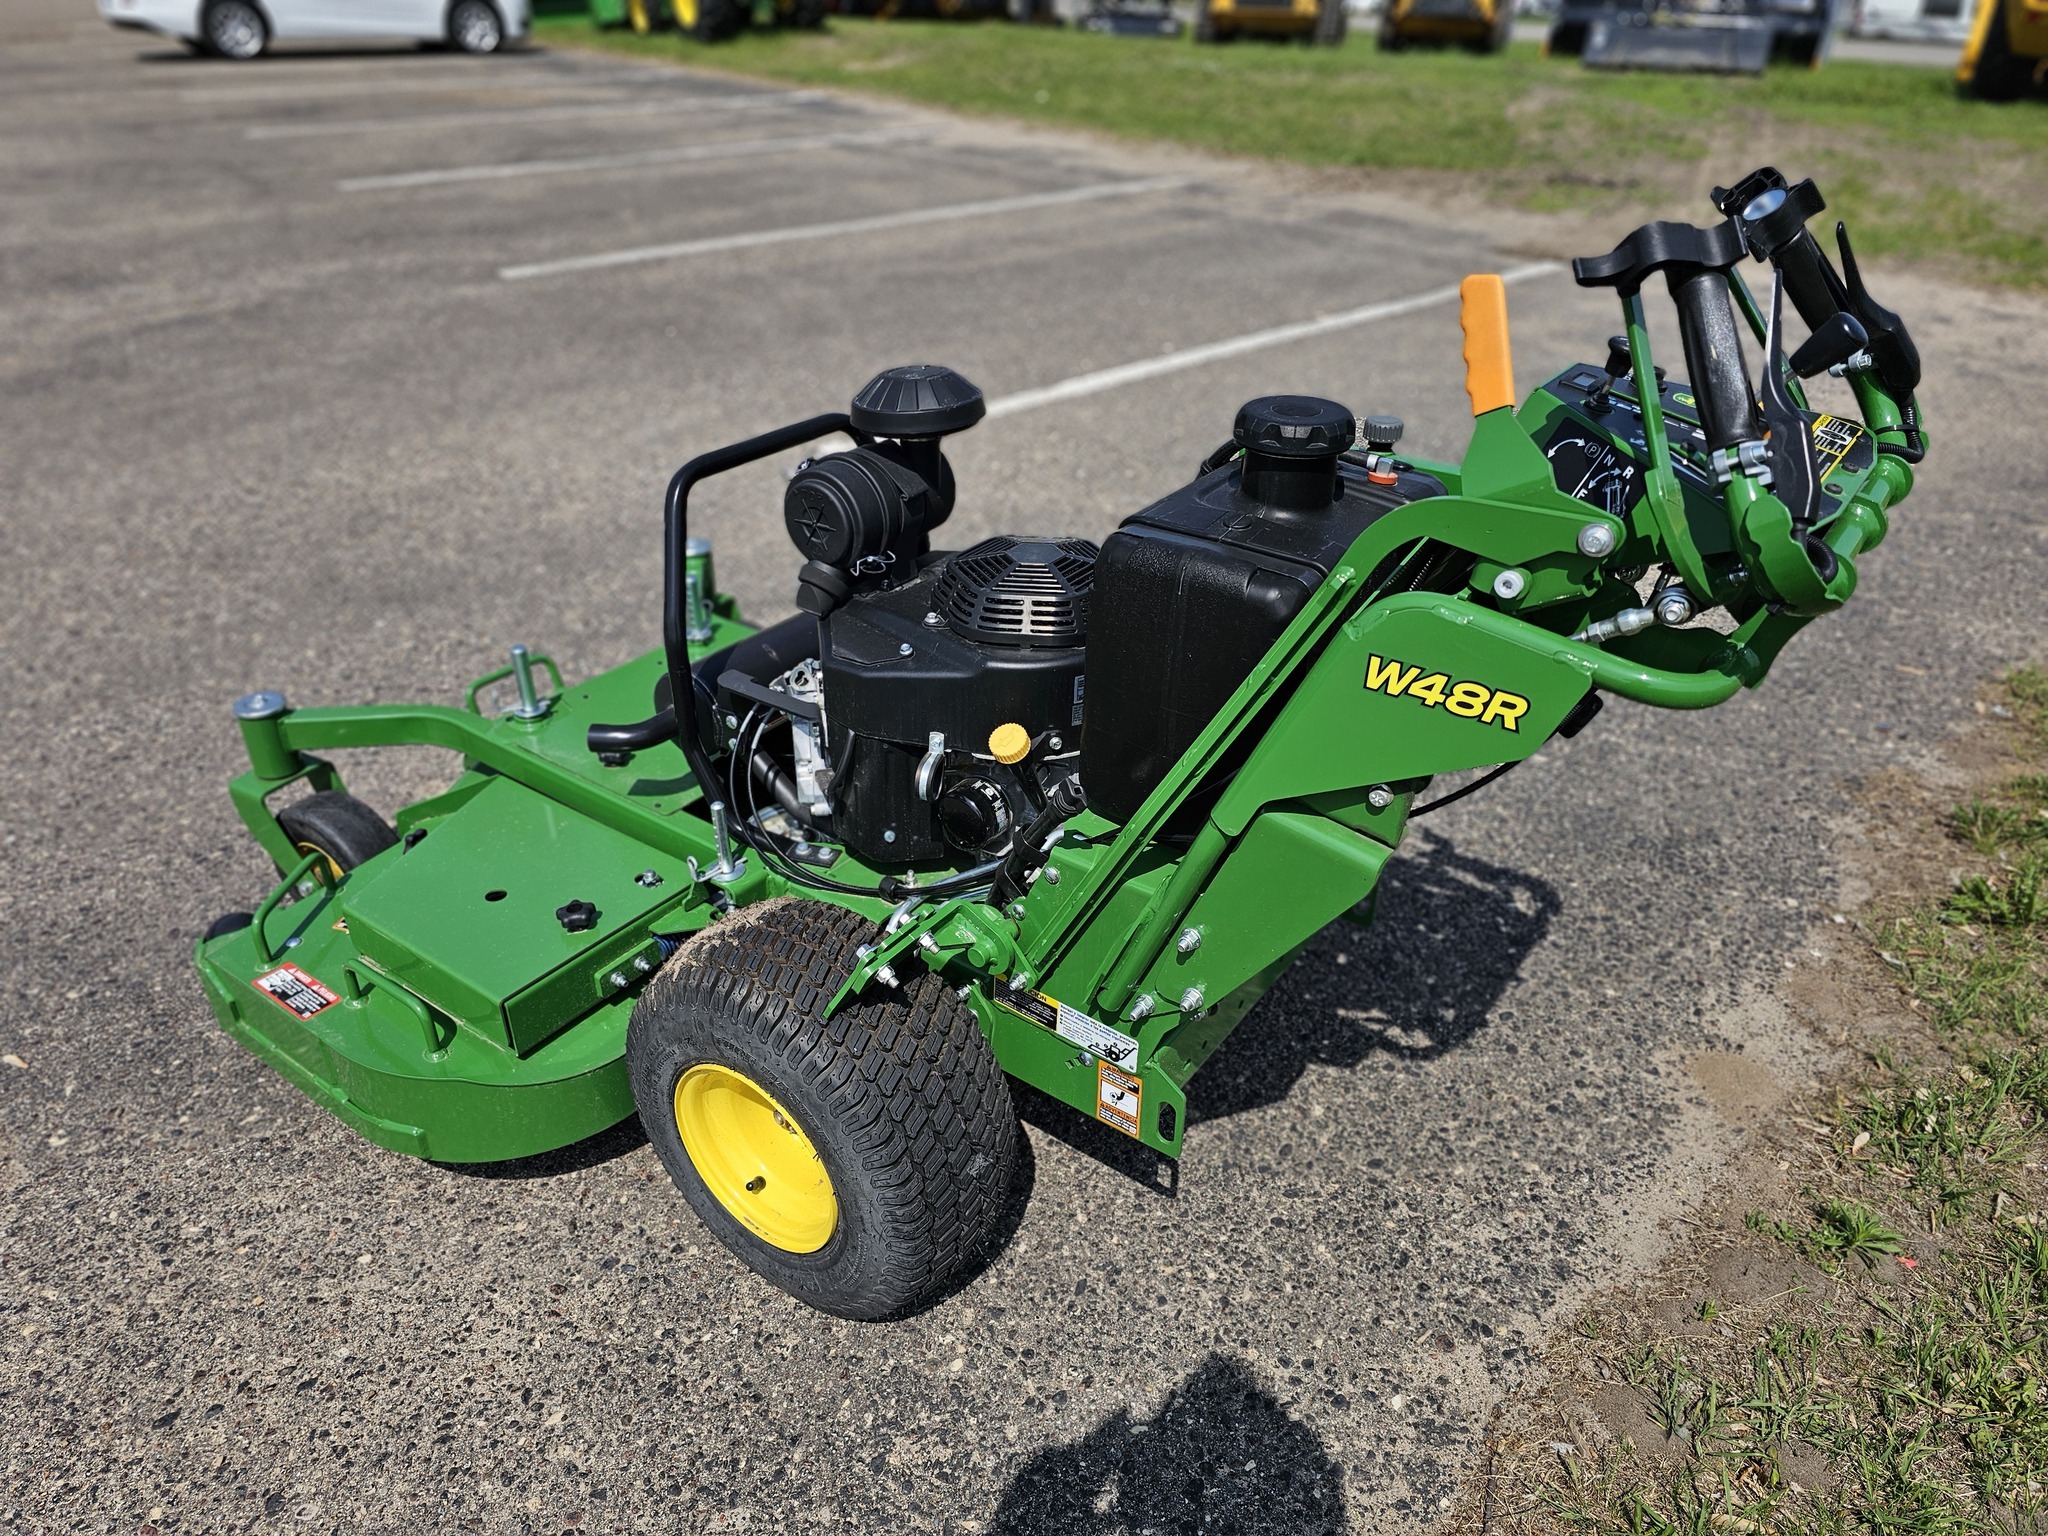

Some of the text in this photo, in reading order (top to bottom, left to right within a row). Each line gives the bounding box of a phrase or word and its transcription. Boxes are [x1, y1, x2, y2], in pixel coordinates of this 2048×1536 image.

[1588, 445, 1597, 454] P
[1603, 454, 1616, 467] N
[1622, 465, 1635, 479] R
[1576, 488, 1589, 499] F
[1363, 652, 1531, 734] W48R
